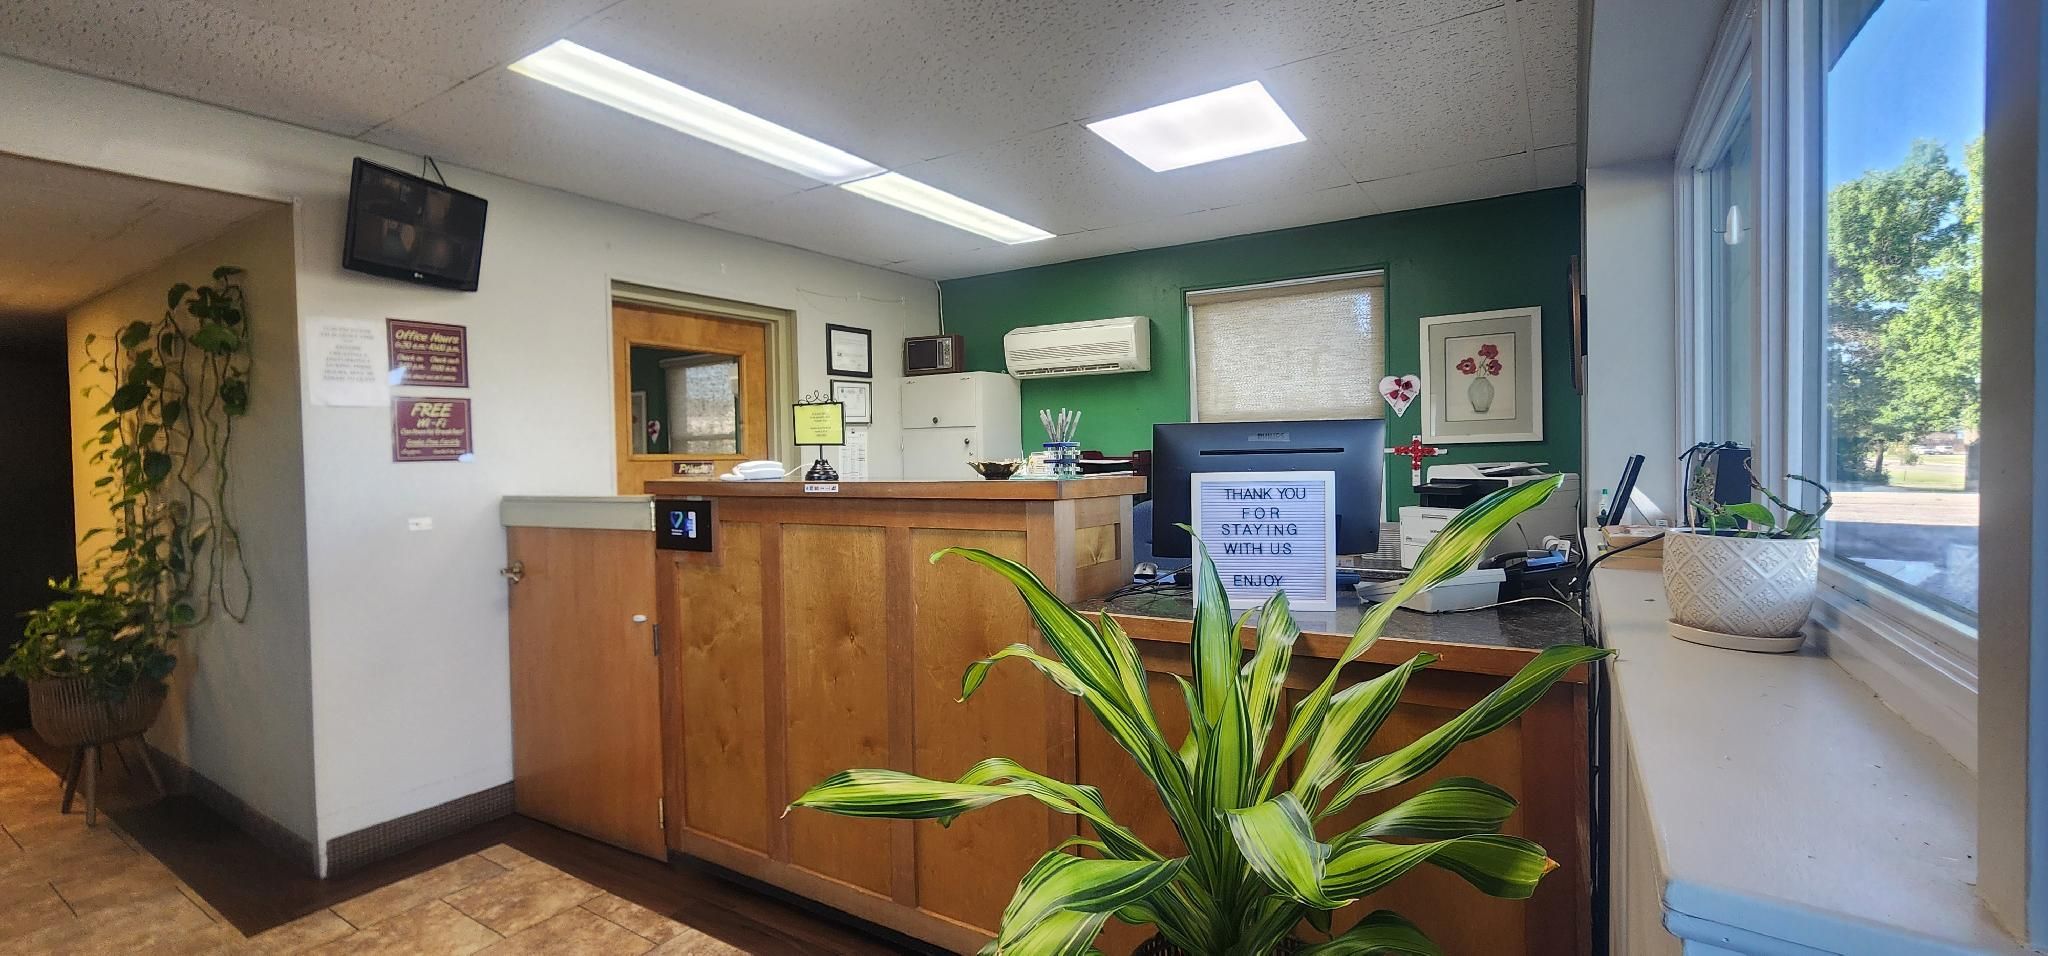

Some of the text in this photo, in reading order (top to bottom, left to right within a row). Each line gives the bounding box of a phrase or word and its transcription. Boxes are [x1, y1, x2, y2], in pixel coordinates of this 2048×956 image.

[395, 329, 460, 345] Office Hours
[411, 402, 453, 418] FREE
[1224, 487, 1306, 500] THANK YOU
[1242, 507, 1280, 519] FOR
[1221, 523, 1297, 536] STAYING
[1223, 543, 1292, 555] WITH US
[1233, 575, 1284, 587] ENJOY
